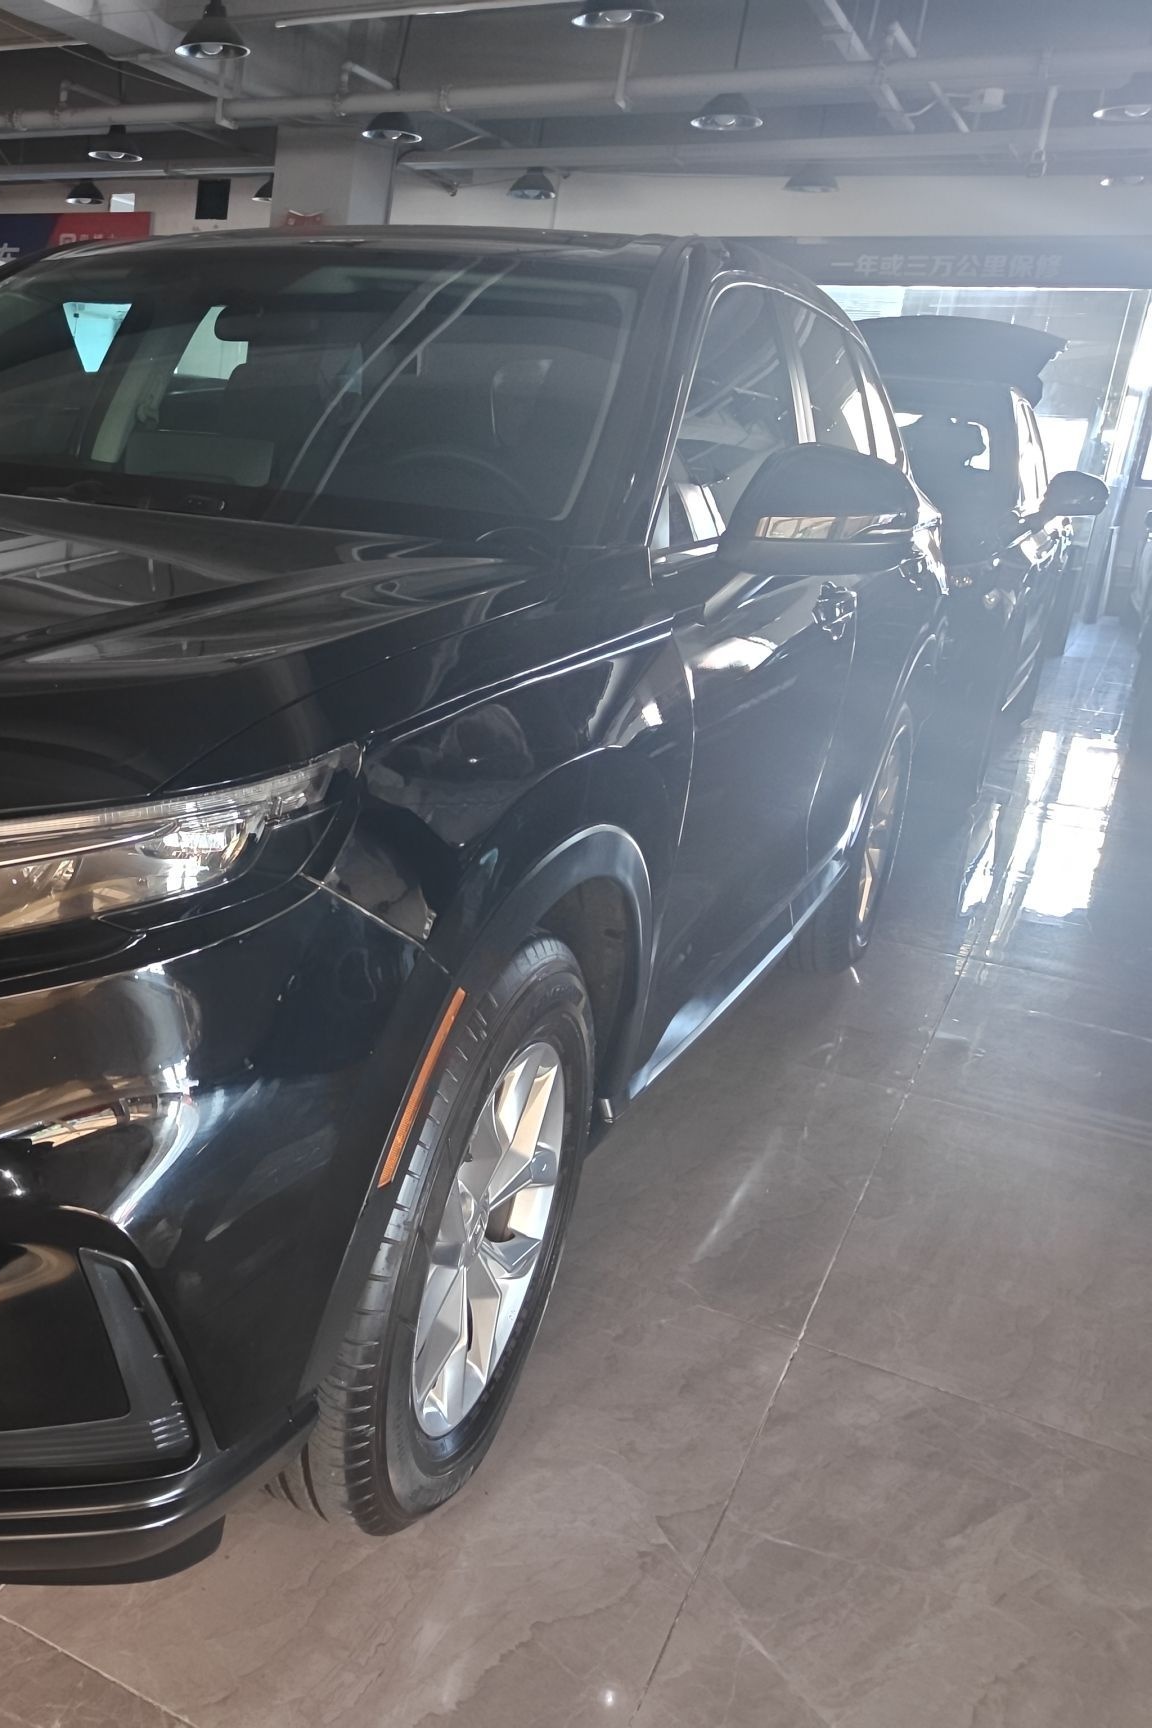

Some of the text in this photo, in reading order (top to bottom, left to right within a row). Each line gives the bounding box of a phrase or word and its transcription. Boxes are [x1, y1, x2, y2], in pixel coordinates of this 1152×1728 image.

[831, 254, 1063, 278] 一年或三万公里保修
